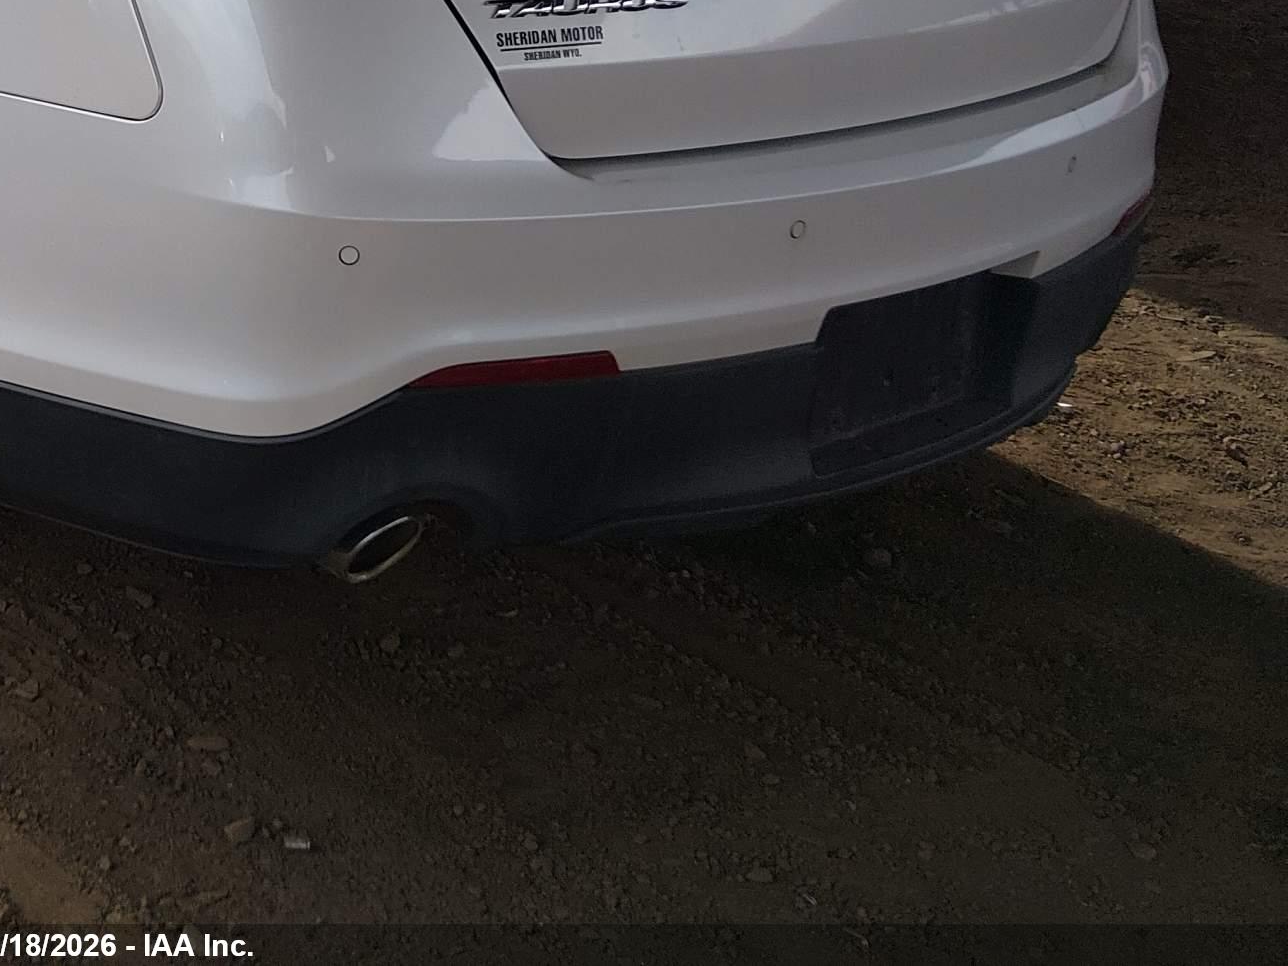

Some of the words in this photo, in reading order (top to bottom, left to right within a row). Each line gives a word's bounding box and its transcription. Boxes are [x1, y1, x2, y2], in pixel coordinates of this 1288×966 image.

[496, 28, 557, 47] SHERIDAN
[561, 25, 604, 42] MOTOR
[524, 50, 561, 61] SHERIDAN
